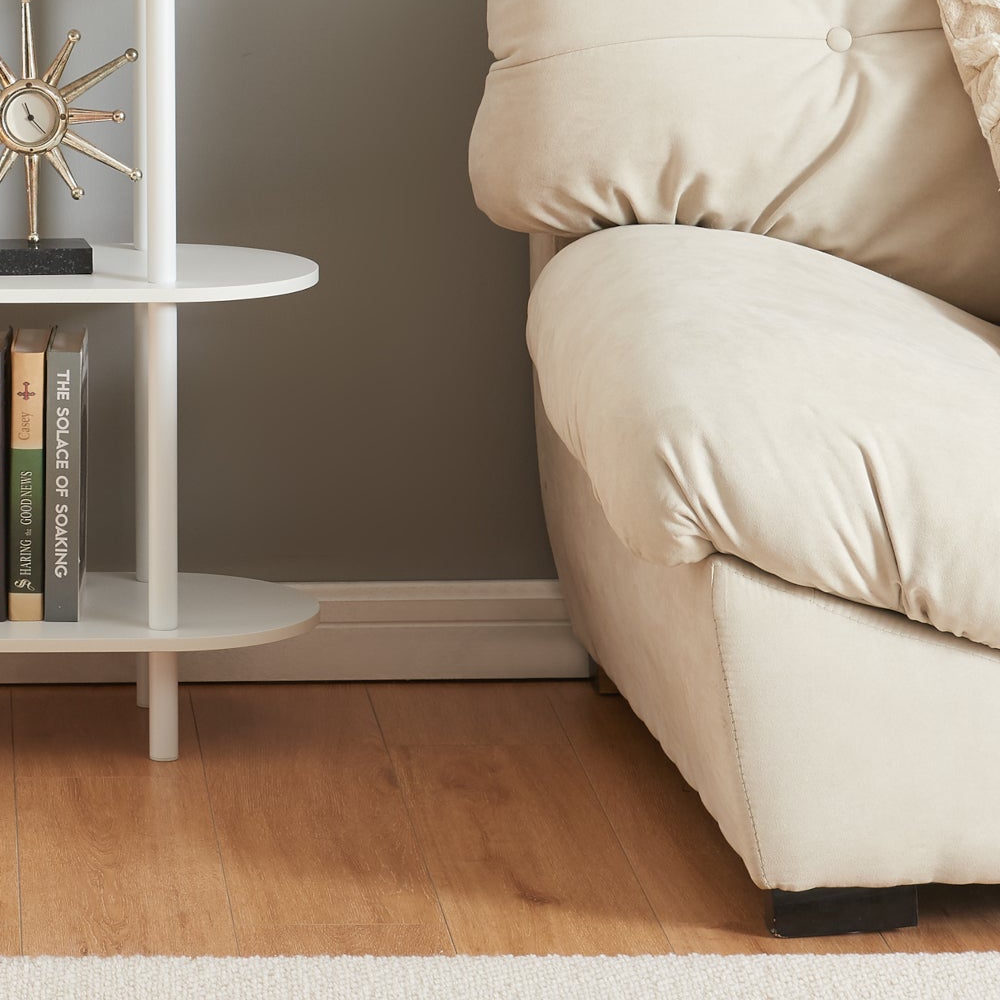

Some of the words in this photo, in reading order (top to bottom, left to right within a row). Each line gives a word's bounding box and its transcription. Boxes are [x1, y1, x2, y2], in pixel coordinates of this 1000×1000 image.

[56, 369, 70, 400] THE
[18, 411, 34, 441] Casey
[56, 407, 70, 469] SOLACE
[19, 471, 33, 497] NEWS
[55, 475, 69, 497] OF
[19, 498, 33, 526] GOOD
[54, 504, 69, 578] SOAKING
